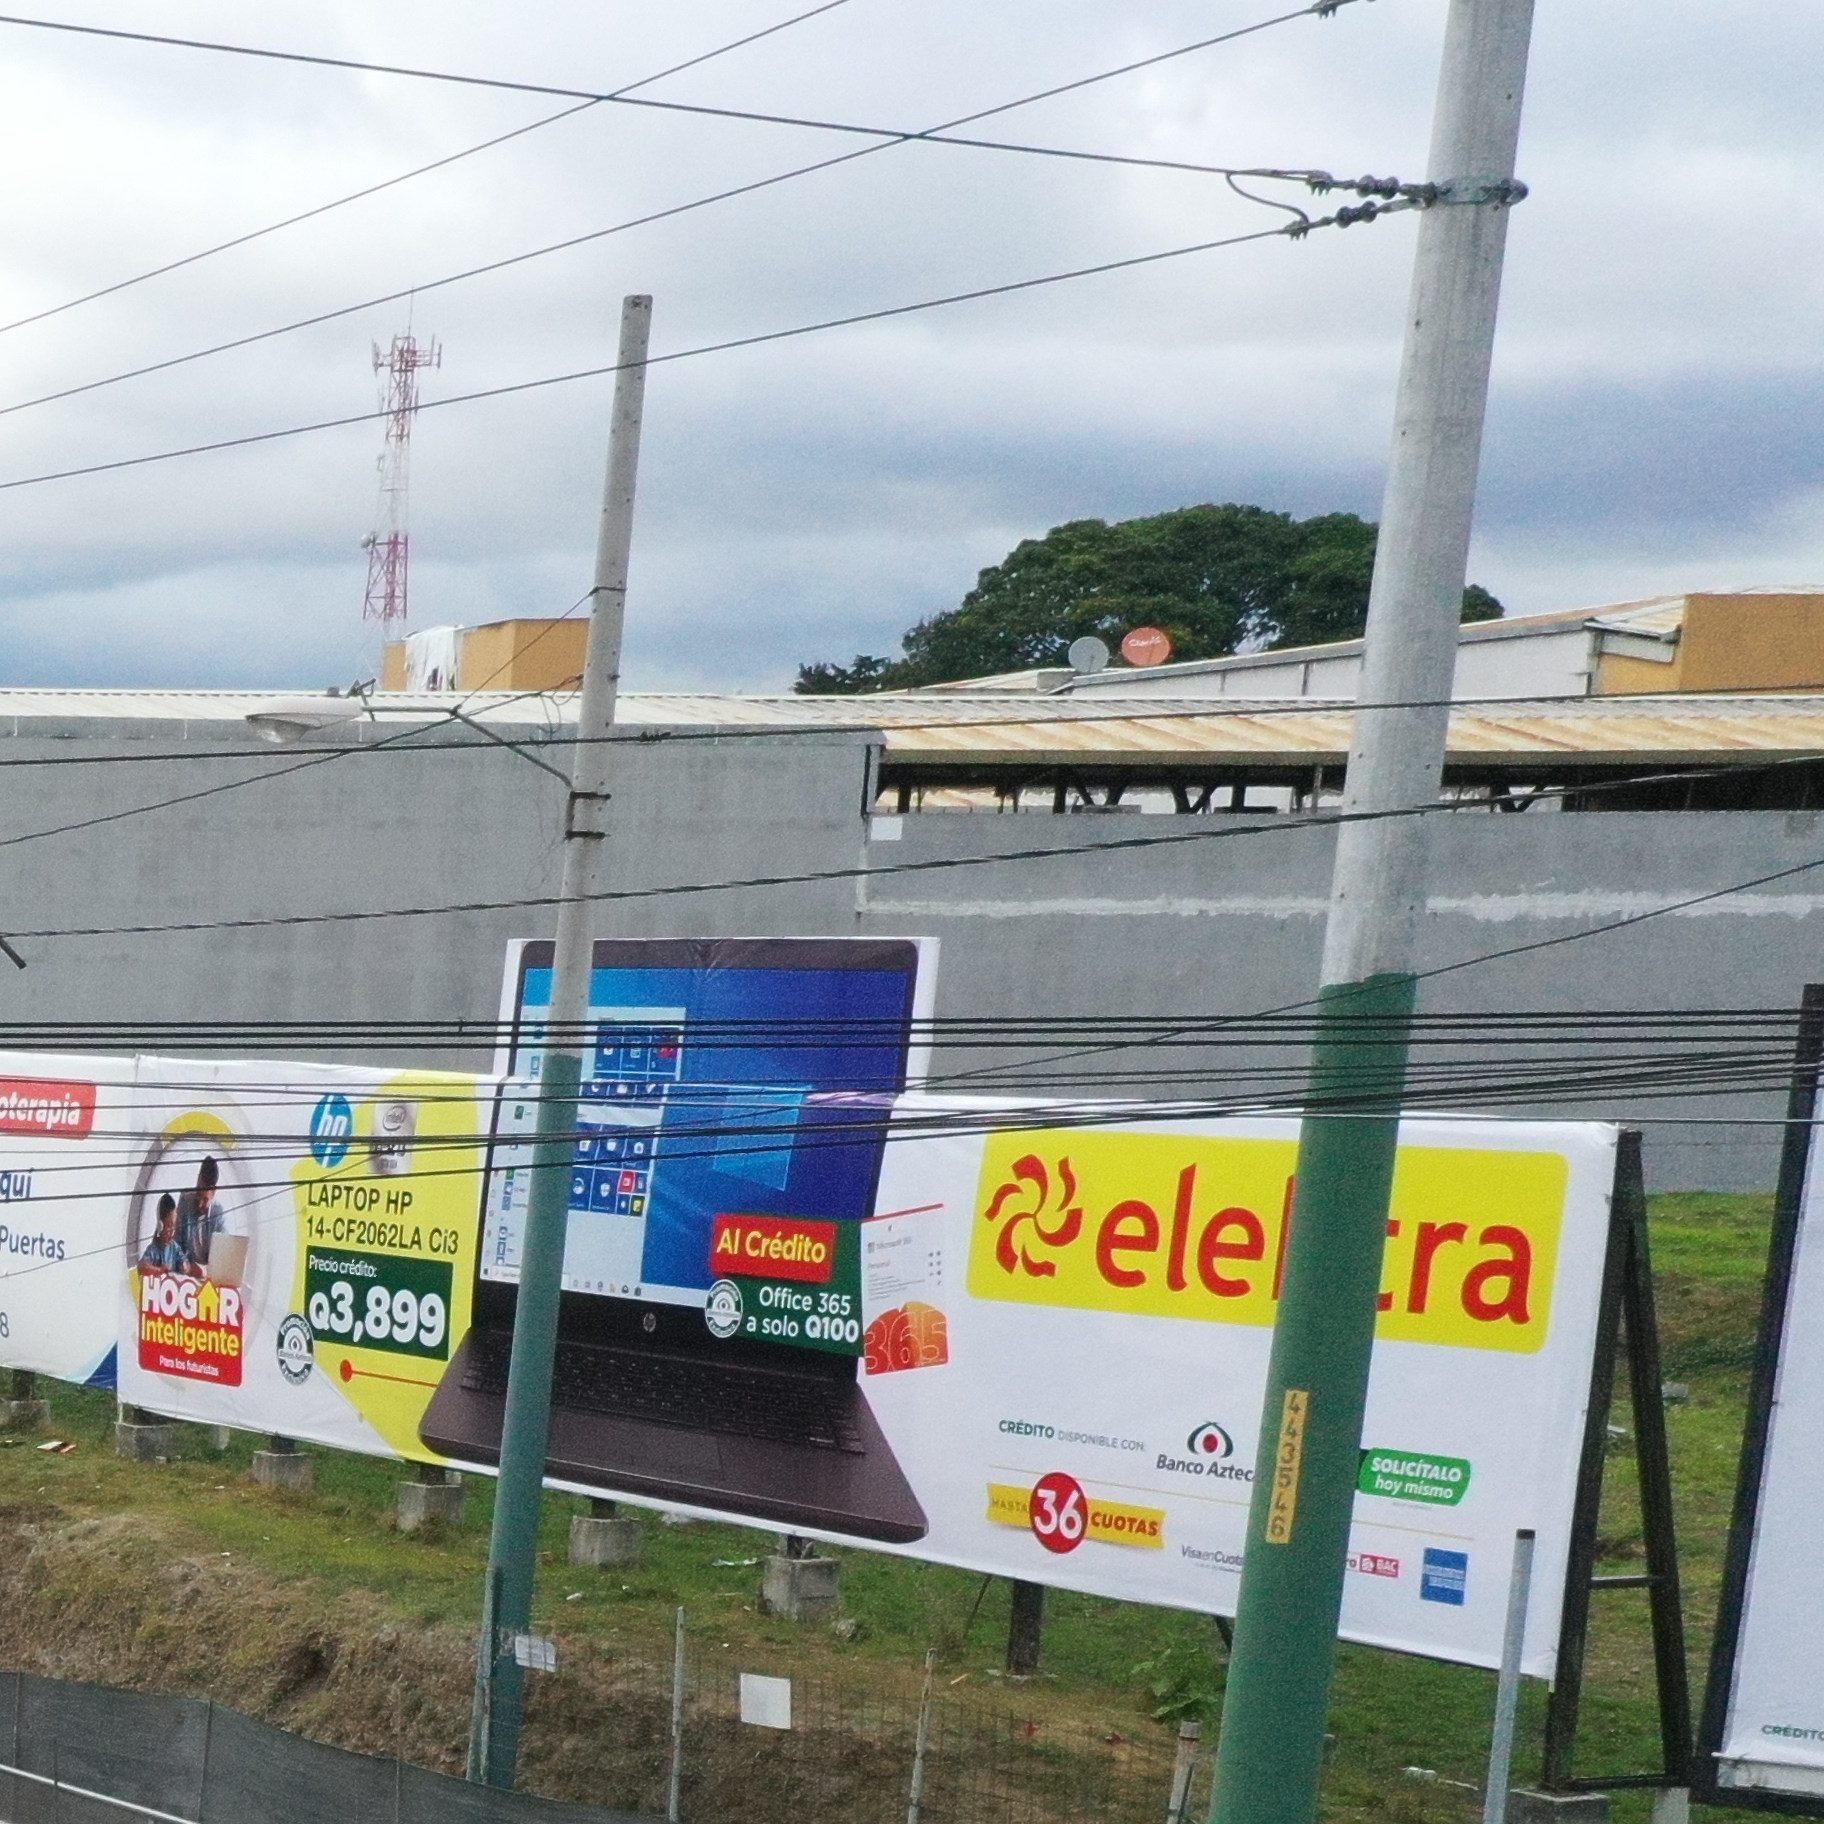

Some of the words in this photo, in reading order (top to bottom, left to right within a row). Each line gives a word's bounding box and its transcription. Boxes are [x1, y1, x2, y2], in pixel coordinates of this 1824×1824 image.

[307, 1183, 381, 1212] LAPTOP
[386, 1190, 413, 1216] HP
[307, 1216, 422, 1251] 14-CF2062LA
[429, 1228, 459, 1255] Ci3
[716, 1228, 740, 1255] Al
[745, 1231, 826, 1264] Crédito
[1095, 1163, 1533, 1326] elera
[309, 1254, 339, 1273] Precio
[339, 1258, 378, 1278] crédito:
[309, 1280, 446, 1348] Q3,899
[759, 1286, 813, 1312] Office
[818, 1292, 852, 1316] 365
[141, 1313, 240, 1357] Inteligente
[746, 1316, 757, 1333] a
[762, 1315, 799, 1337] solo
[804, 1315, 860, 1343] Q100
[998, 1418, 1054, 1440] CRÉDITO
[1057, 1429, 1118, 1449] DISPONIBLE
[1156, 1454, 1204, 1475] Banco
[1207, 1461, 1256, 1482] Aztec
[1371, 1457, 1463, 1483] SOLICÍTALO
[1374, 1475, 1402, 1495] hoy
[1034, 1488, 1082, 1540] 36
[1090, 1512, 1158, 1537] CUOTAS
[1376, 1559, 1397, 1573] BAC
